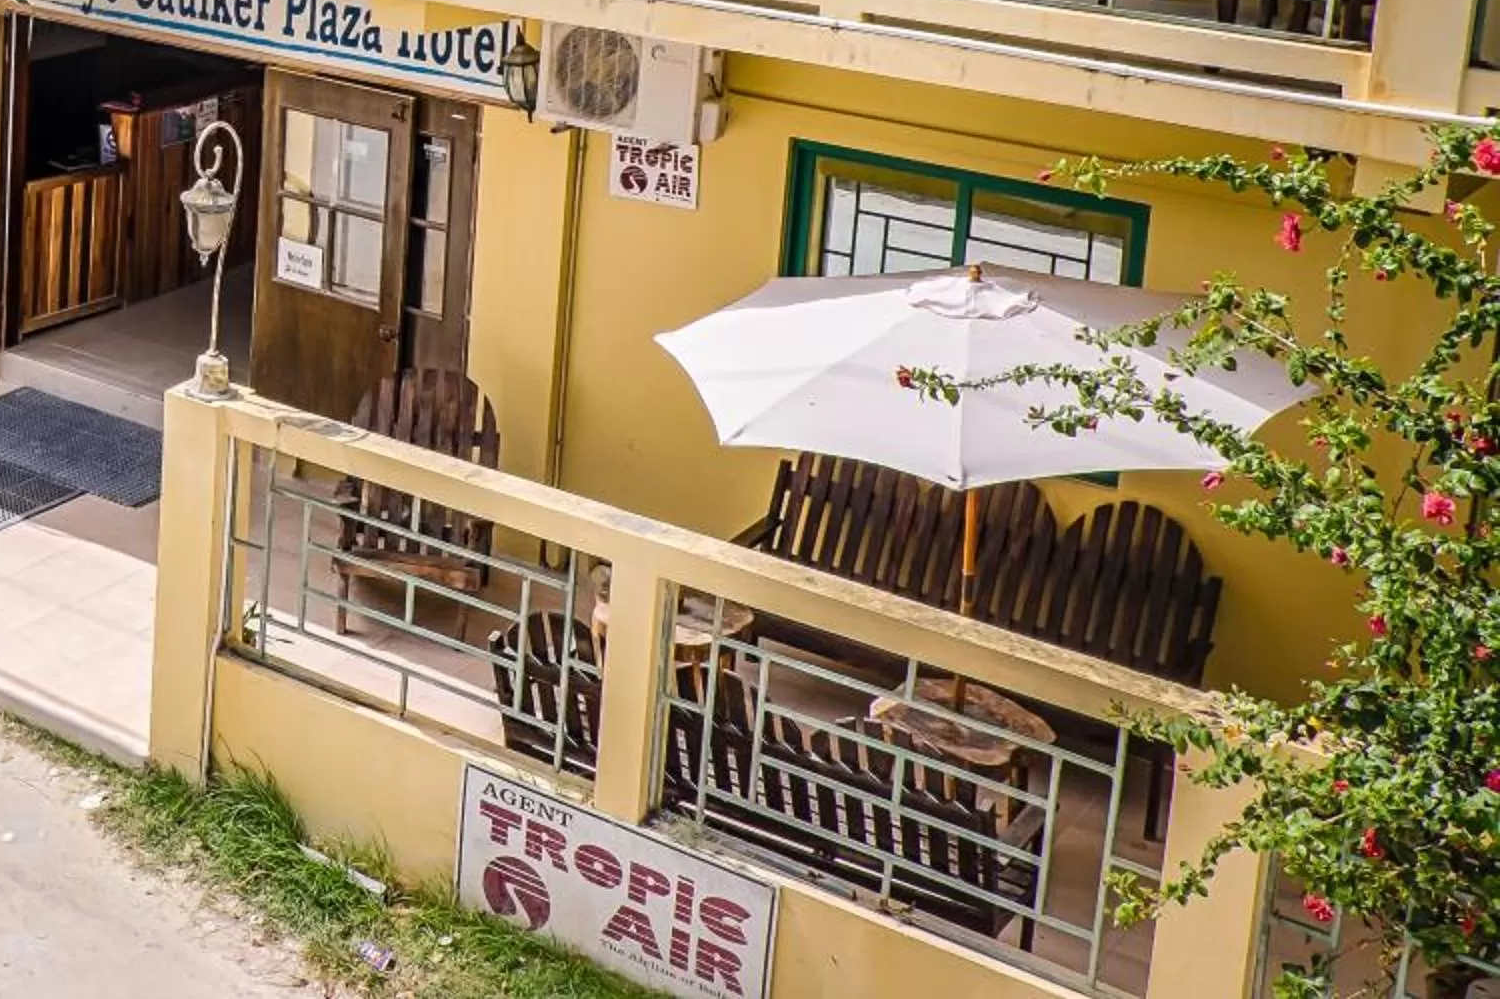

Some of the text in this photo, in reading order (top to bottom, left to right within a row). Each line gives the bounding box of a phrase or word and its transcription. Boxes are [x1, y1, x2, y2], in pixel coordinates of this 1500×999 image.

[655, 172, 691, 198] AIR
[483, 781, 574, 827] AGENT
[602, 904, 743, 997] AIR
